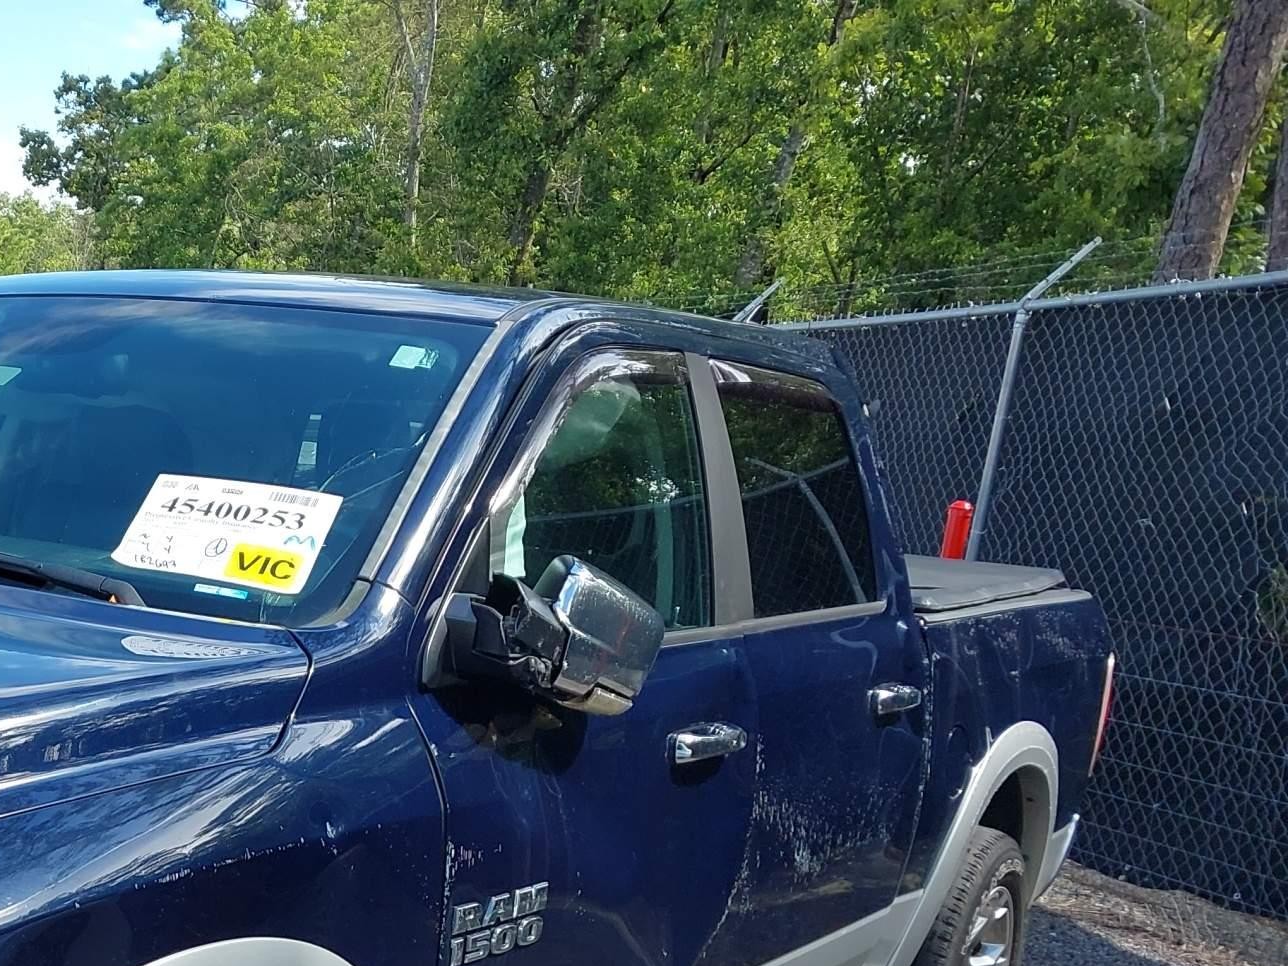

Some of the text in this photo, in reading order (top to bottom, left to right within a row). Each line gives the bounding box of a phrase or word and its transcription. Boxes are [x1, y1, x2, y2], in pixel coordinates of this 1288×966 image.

[160, 496, 307, 530] 45400253
[237, 551, 296, 580] VIC
[451, 881, 550, 935] RAM
